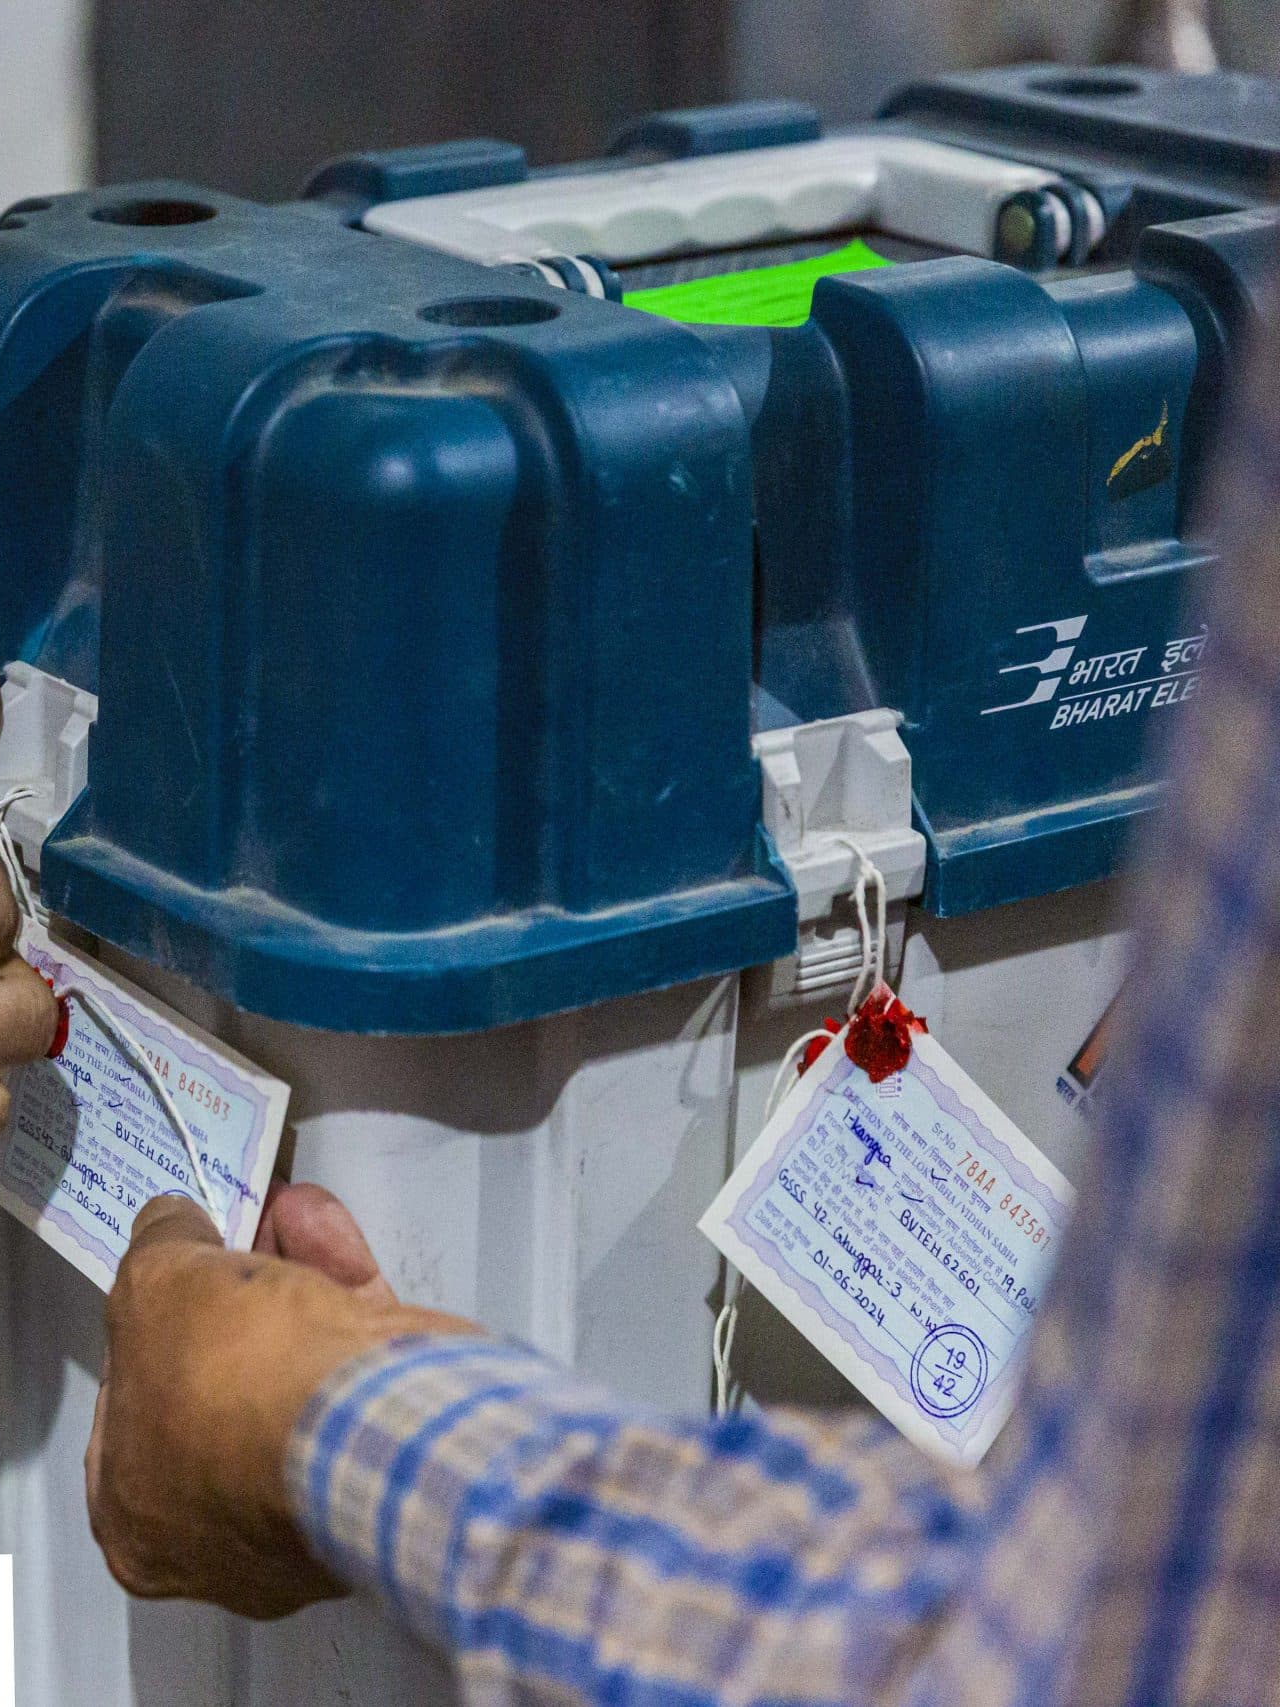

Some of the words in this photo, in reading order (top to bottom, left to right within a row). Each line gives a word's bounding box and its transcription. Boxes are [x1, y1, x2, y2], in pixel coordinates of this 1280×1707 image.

[1069, 647, 1148, 685] भारत
[1049, 687, 1152, 730] BHARAT
[1150, 674, 1204, 708] ELE
[54, 1053, 92, 1087] angra
[951, 1172, 969, 1193] सभा
[956, 1150, 996, 1195] 78AA
[61, 1179, 117, 1236] 01-06-2024
[881, 1125, 897, 1143] TO
[892, 1136, 914, 1161] THE
[911, 1155, 931, 1177] LOK
[958, 1203, 994, 1241] VIDHAN
[990, 1235, 1020, 1267] SABHA
[814, 1249, 885, 1327] 01-06-2024
[946, 1347, 968, 1371] 19
[931, 1374, 957, 1397] 42
